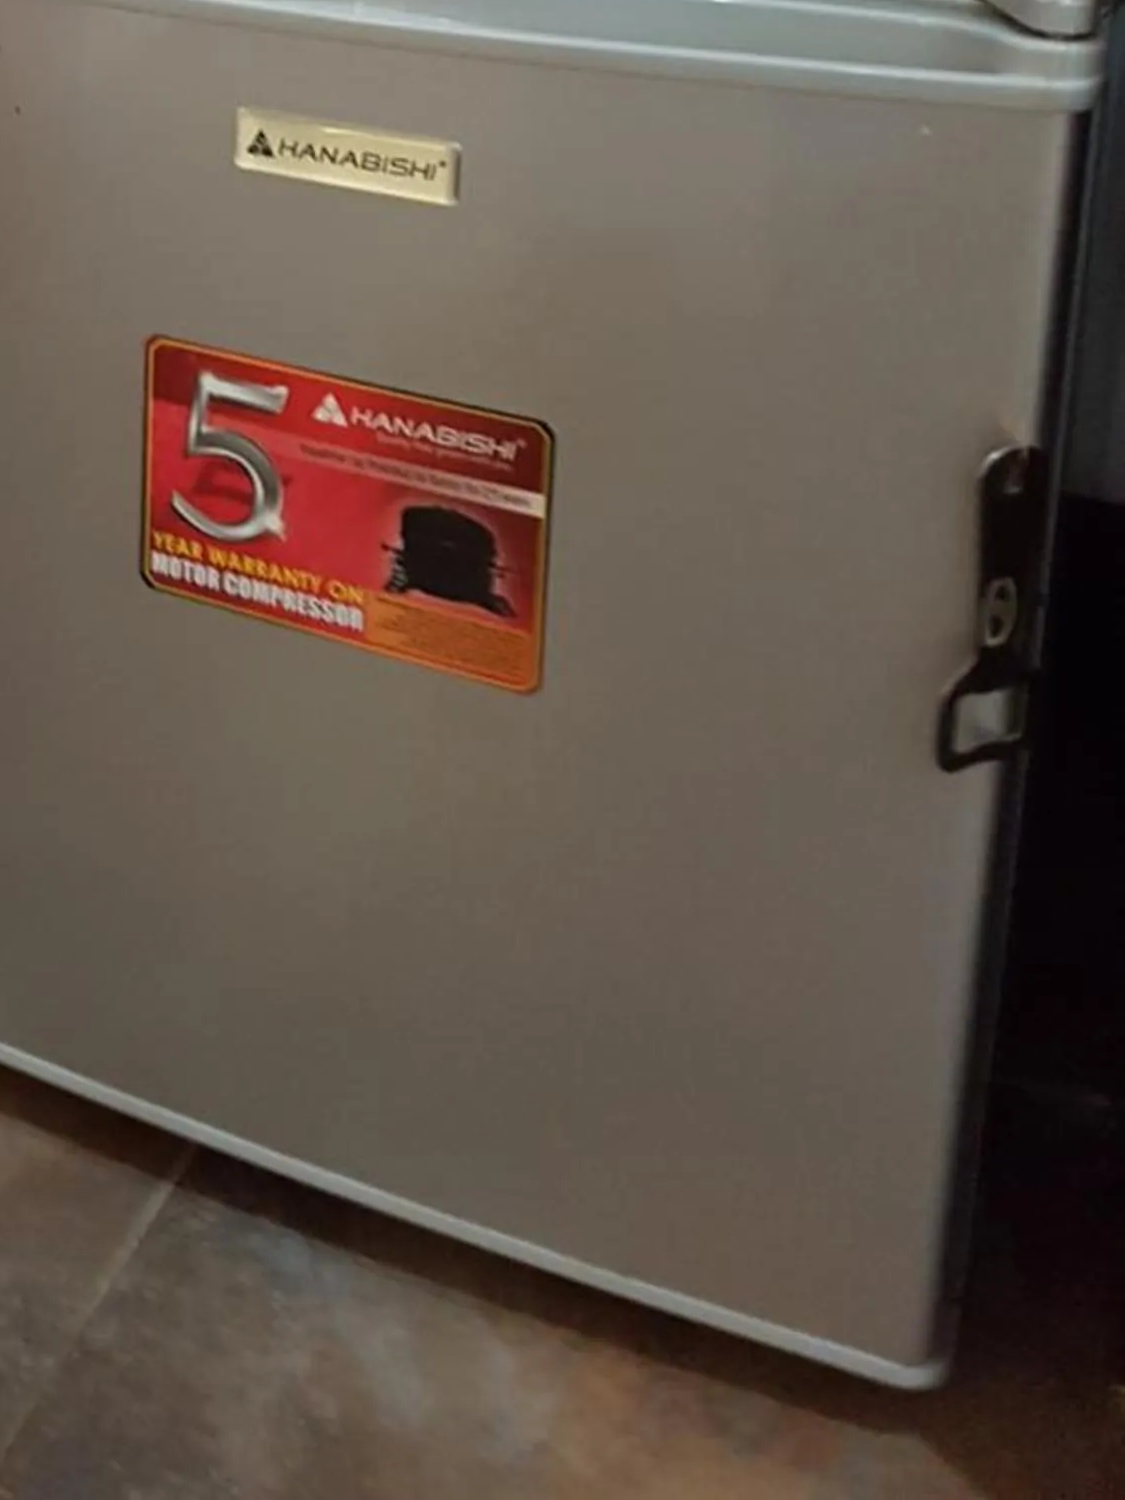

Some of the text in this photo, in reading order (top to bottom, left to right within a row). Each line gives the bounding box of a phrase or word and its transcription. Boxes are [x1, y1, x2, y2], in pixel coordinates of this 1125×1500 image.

[278, 138, 438, 181] HANABISHI
[171, 371, 290, 543] 5
[350, 406, 516, 461] HANABISHI
[151, 552, 364, 632] MOTOR COMPRESSOR
[152, 531, 365, 604] YEAR WARRANTY ON
